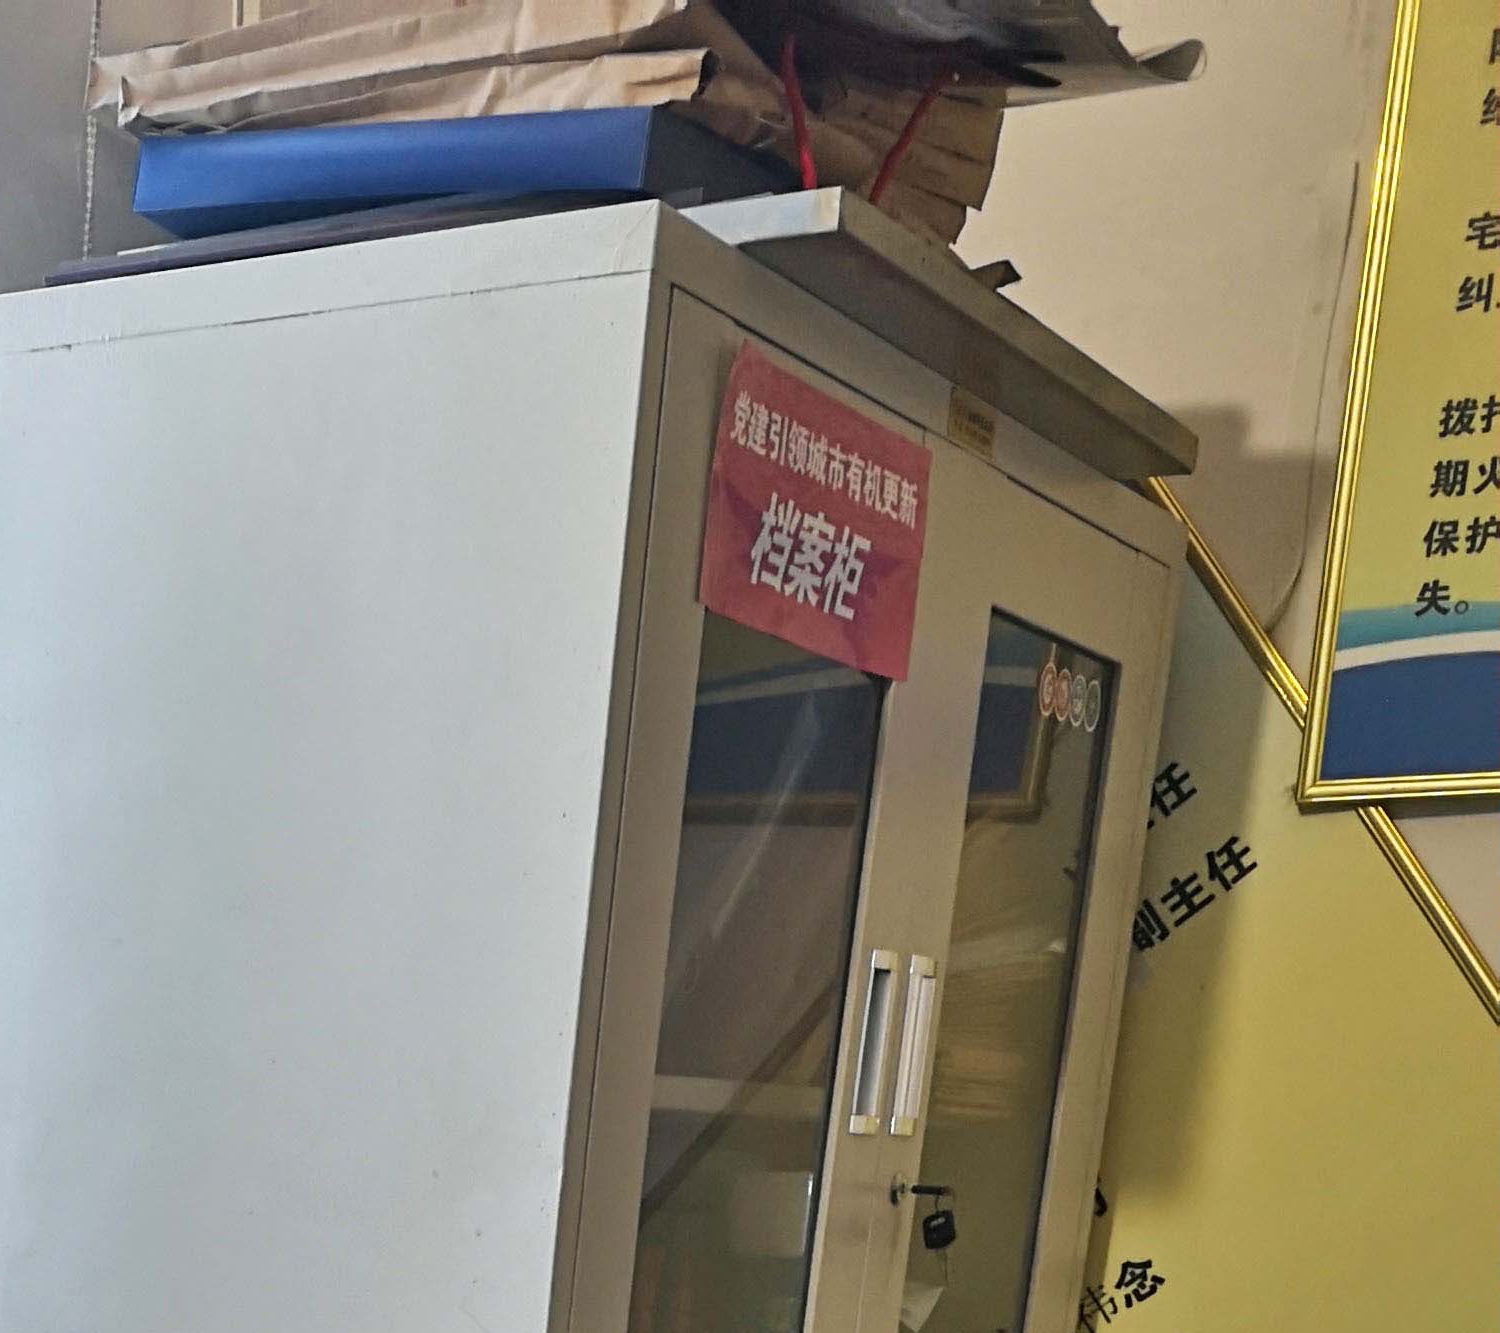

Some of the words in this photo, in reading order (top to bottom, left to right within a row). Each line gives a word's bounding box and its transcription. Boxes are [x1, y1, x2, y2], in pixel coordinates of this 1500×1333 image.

[731, 390, 920, 531] 党建引领城市有机更新
[748, 492, 873, 622] 档案柜
[1146, 761, 1199, 830] 任
